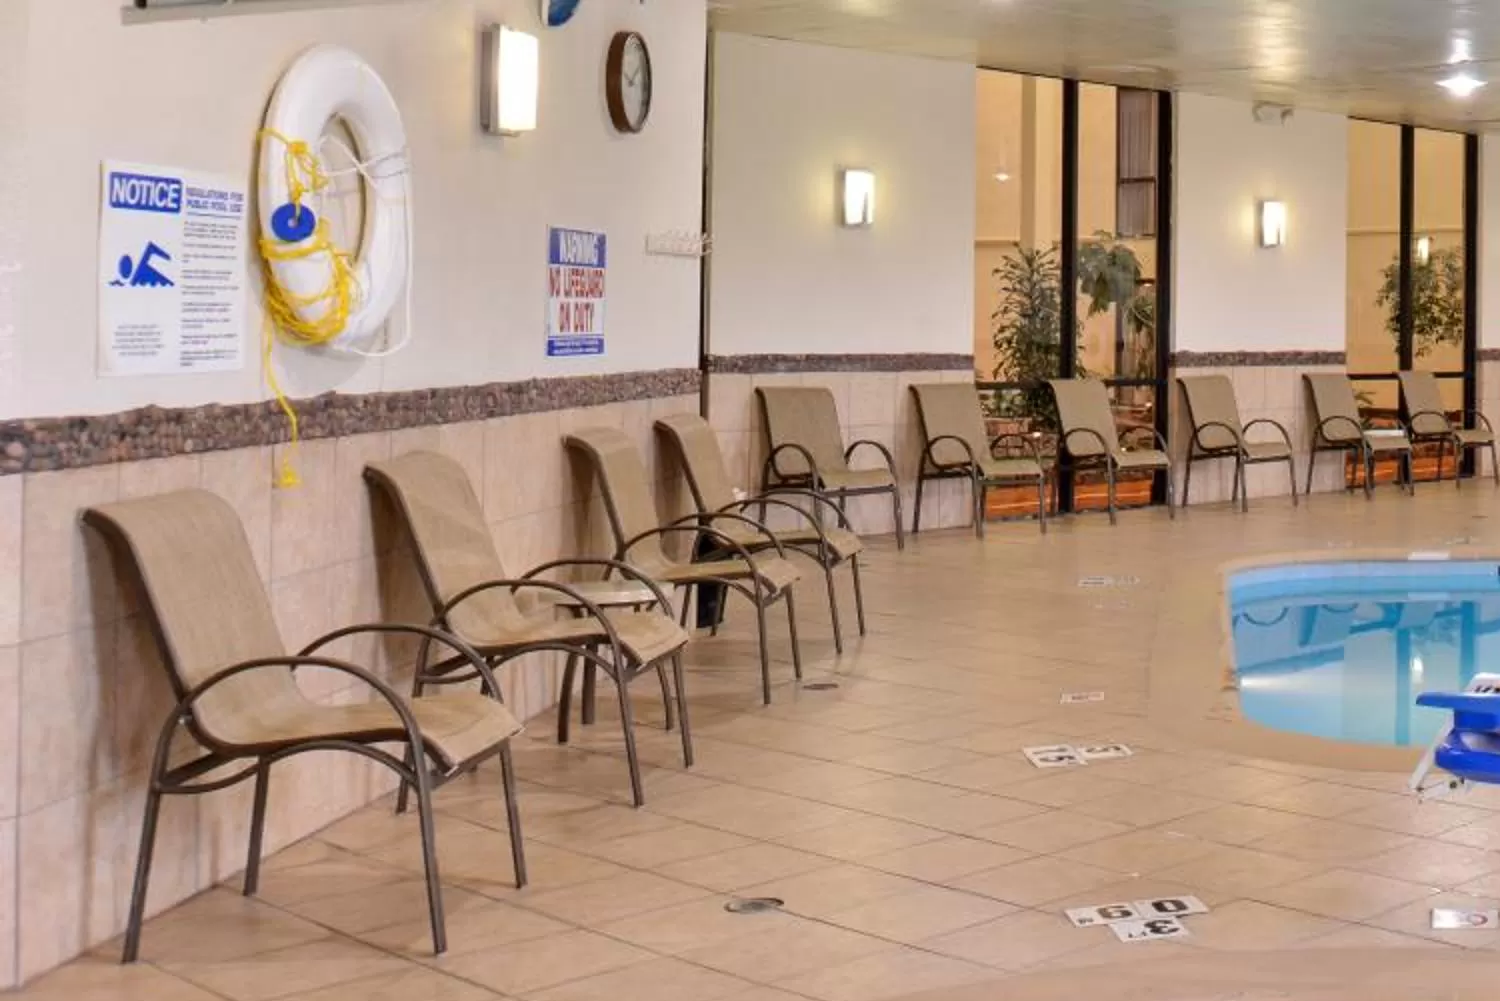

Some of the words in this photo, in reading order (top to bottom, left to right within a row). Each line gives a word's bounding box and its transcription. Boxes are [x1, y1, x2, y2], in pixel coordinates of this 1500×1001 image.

[111, 177, 180, 208] NOTICE
[560, 232, 598, 263] WARNING
[549, 268, 561, 297] NO
[564, 267, 604, 298] LIFEGUARD
[559, 302, 570, 332] ON
[574, 302, 594, 332] DUTY
